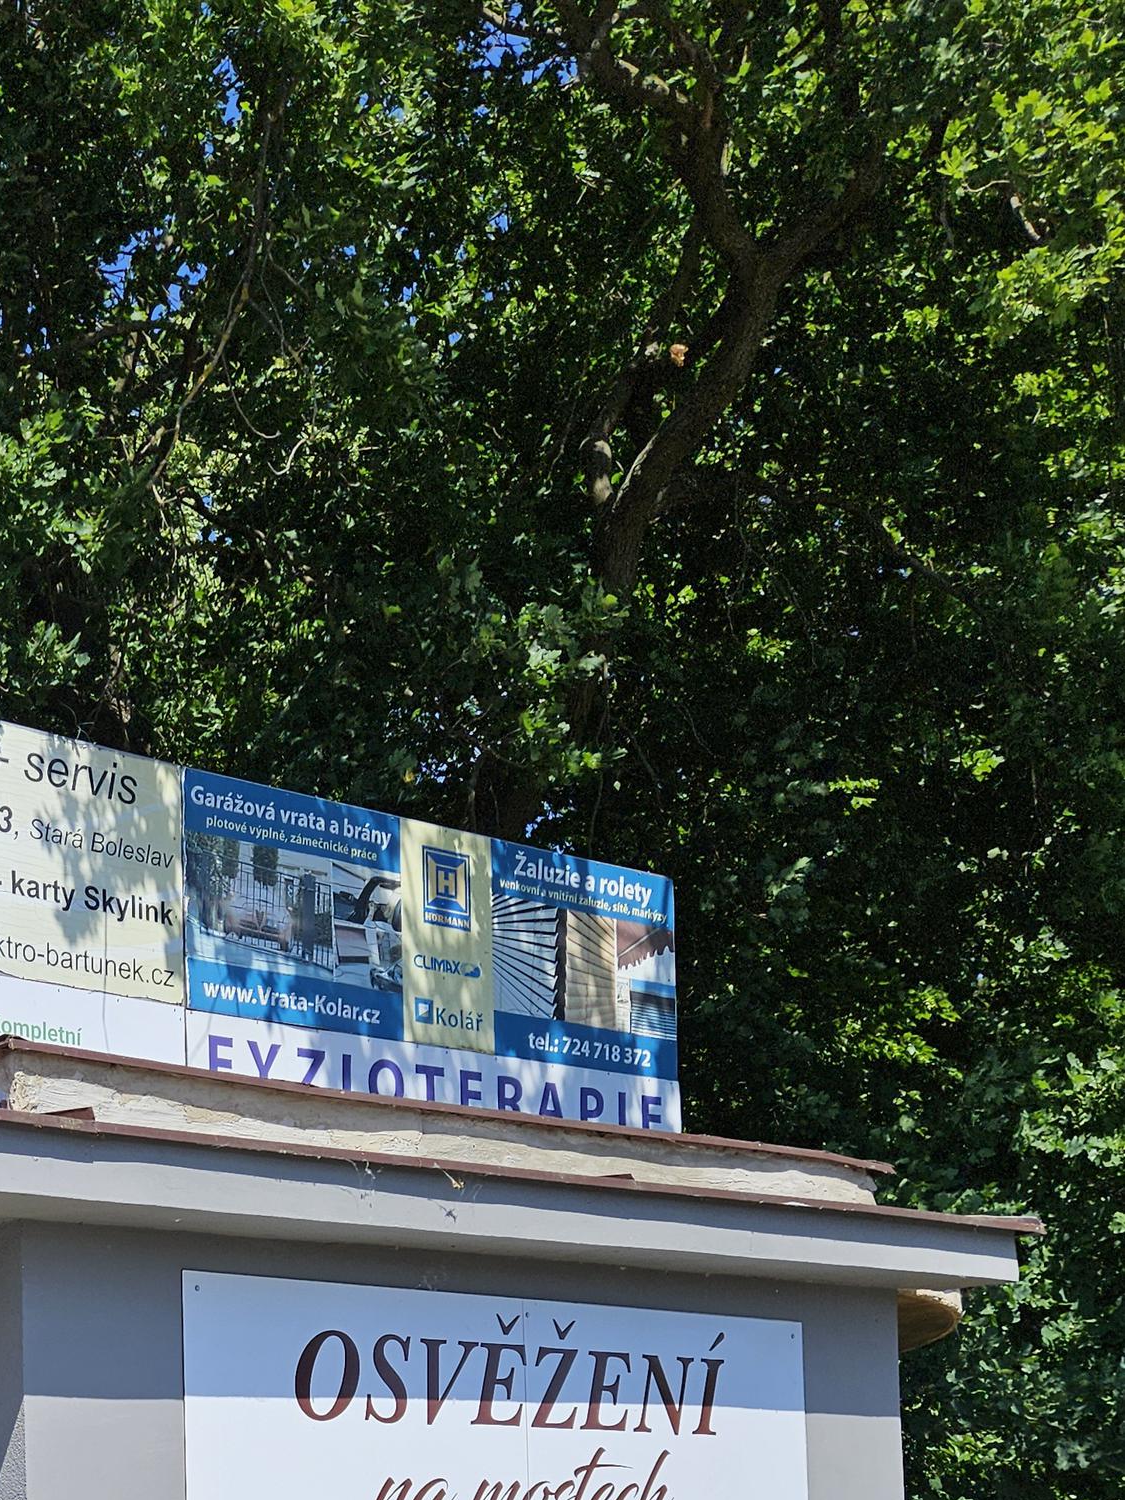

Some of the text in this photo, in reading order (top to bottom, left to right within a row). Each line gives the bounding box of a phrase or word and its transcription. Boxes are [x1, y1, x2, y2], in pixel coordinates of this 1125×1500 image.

[24, 751, 138, 805] servis
[190, 785, 392, 851] Garážová vrata a brány
[206, 815, 378, 862] plotové výplně, zámečnické práce
[29, 818, 83, 850] Stará
[90, 831, 175, 869] Boleslav
[11, 870, 76, 911] karty
[84, 885, 174, 926] Skylink
[499, 878, 541, 897] venkovní
[632, 907, 668, 924] markýzy
[514, 850, 653, 909] Žaluzie a rolety
[413, 953, 461, 976] CLIMAX
[203, 979, 381, 1026] www.Vrata-Kolar.cz
[435, 1007, 484, 1032] Kolář
[527, 1031, 651, 1068] tel.: 724 718 372
[293, 1312, 726, 1437] OSVĚŽENÍ
